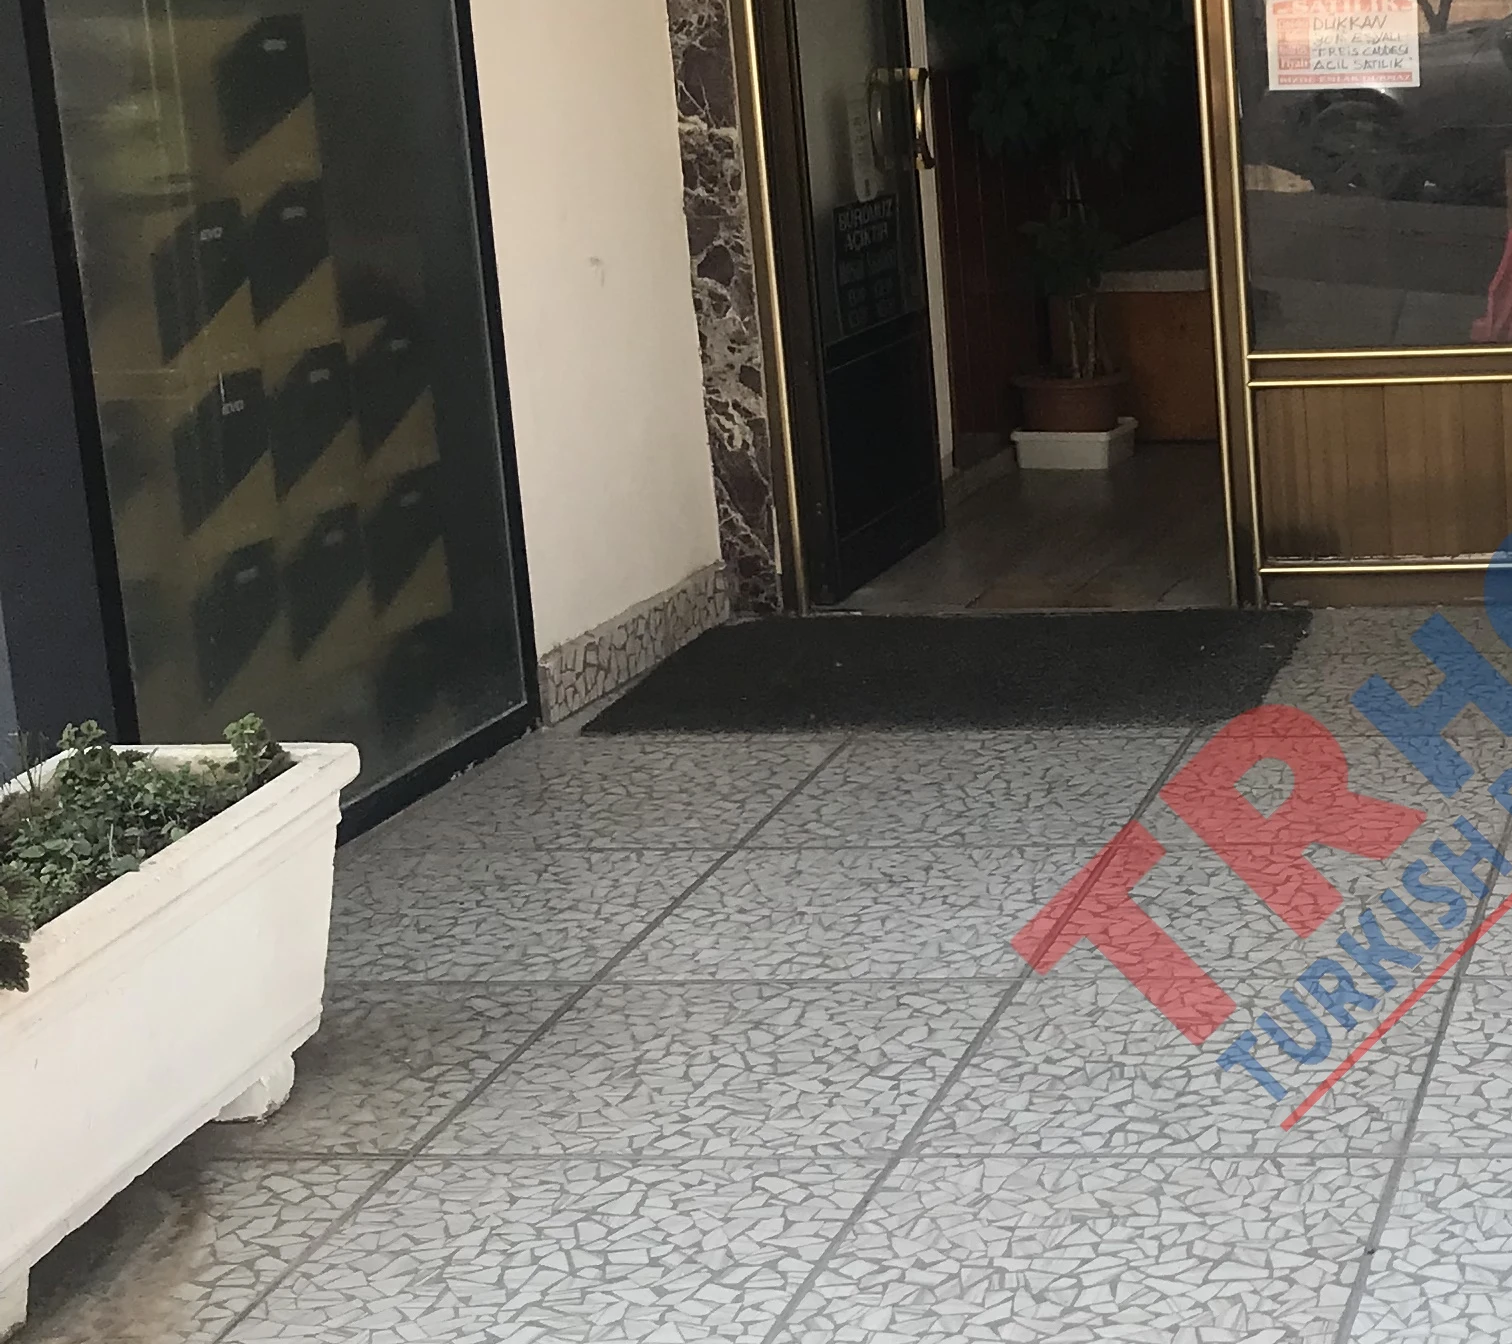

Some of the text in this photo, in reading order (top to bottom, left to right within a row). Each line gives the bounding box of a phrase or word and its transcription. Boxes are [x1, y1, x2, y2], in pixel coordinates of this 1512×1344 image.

[1291, 0, 1398, 13] SATILIK
[1313, 13, 1387, 31] DÜKKAN
[1353, 58, 1403, 71] SATILIK
